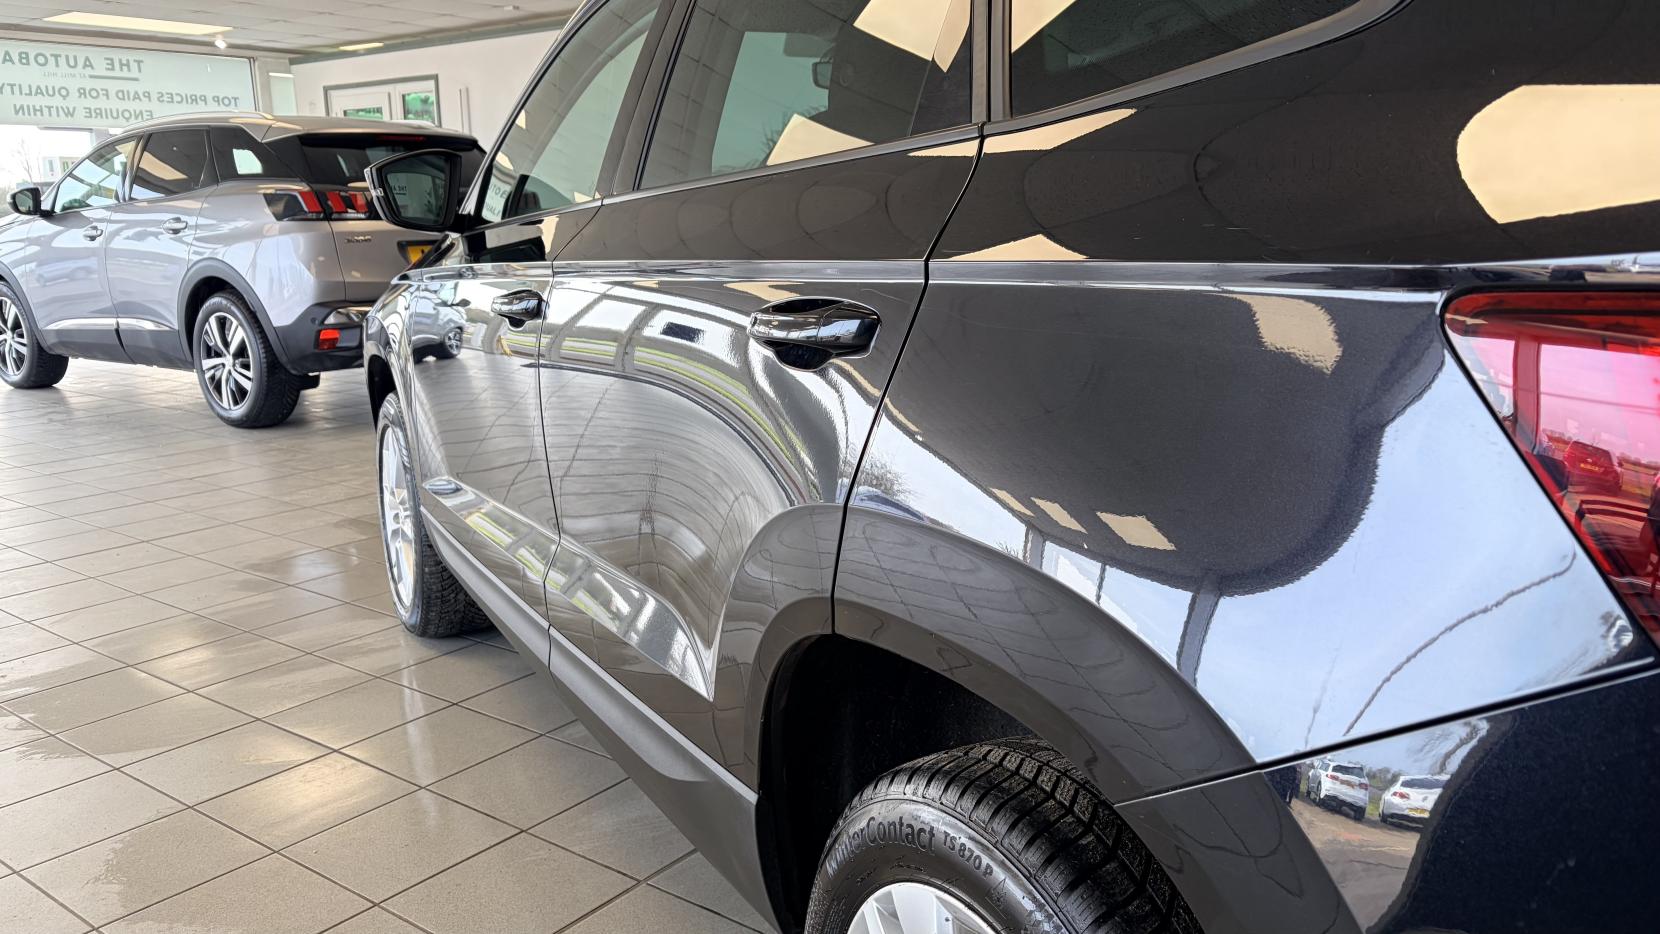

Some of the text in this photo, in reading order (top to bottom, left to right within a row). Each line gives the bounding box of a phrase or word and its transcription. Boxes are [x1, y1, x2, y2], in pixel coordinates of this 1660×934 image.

[943, 830, 958, 852] TS
[958, 842, 982, 871] 870
[982, 863, 993, 878] P
